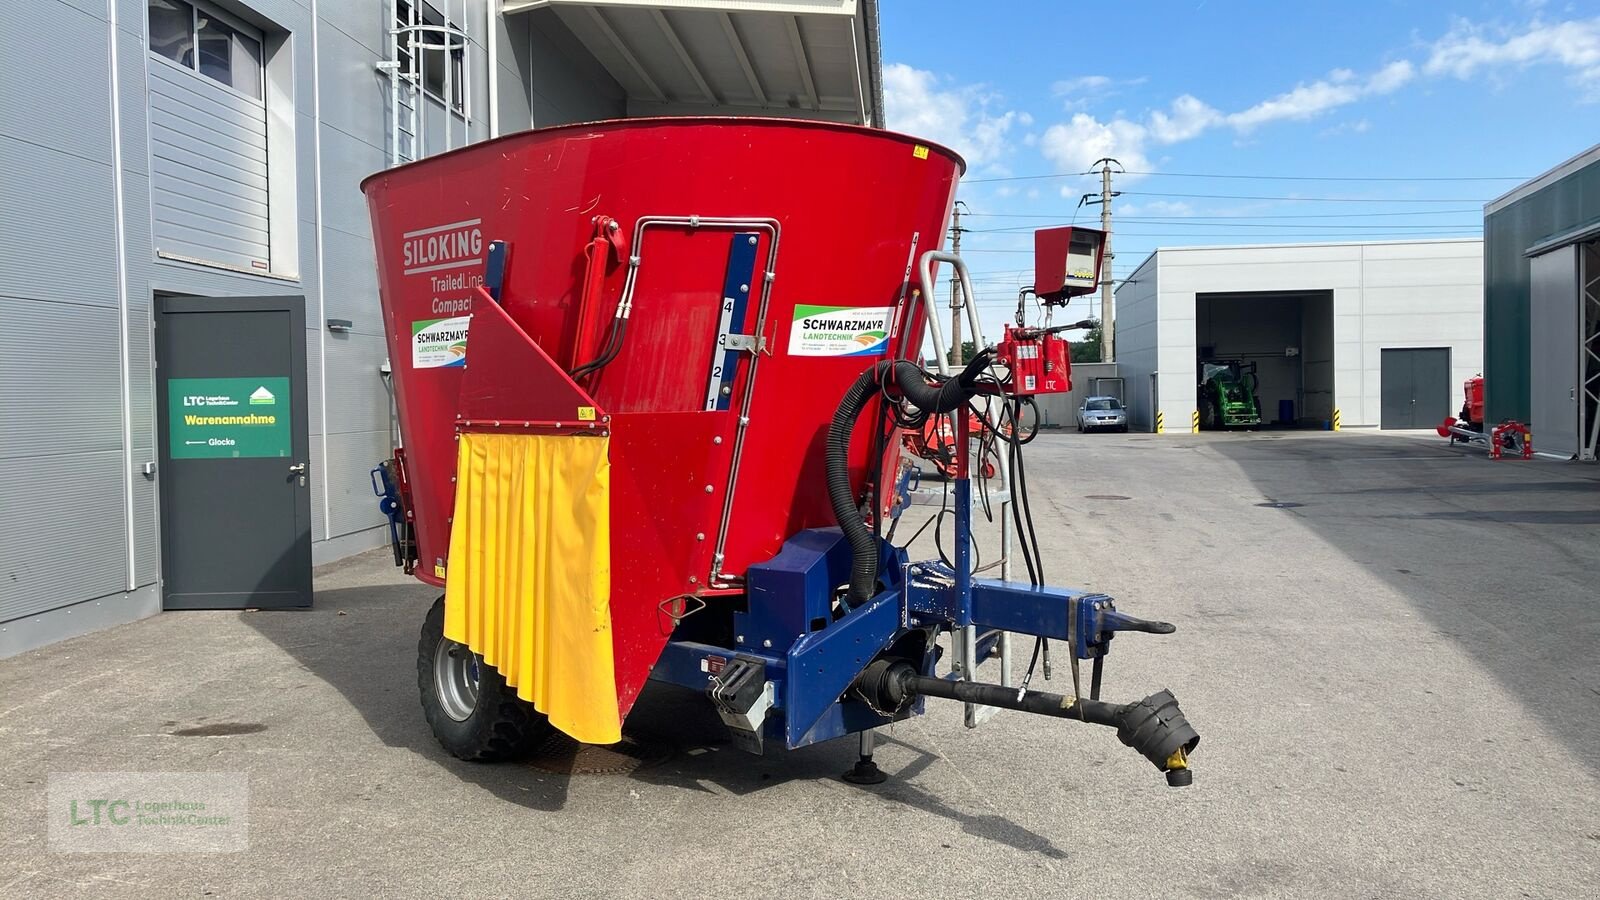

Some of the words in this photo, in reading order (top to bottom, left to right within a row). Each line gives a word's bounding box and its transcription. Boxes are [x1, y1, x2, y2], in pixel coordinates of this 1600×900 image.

[403, 228, 482, 266] SILOKING
[431, 272, 484, 292] TrailedLine
[723, 302, 732, 313] 4
[802, 319, 884, 331] SCHWARZMAYR
[719, 333, 726, 345] 3
[802, 333, 853, 341] LANDTECHNIK
[418, 345, 449, 353] LANDTECHNIK
[713, 366, 722, 378] 2
[183, 396, 205, 406] LTC
[708, 398, 715, 409] 1
[184, 414, 276, 425] Warenannahme
[208, 438, 236, 446] Glocke
